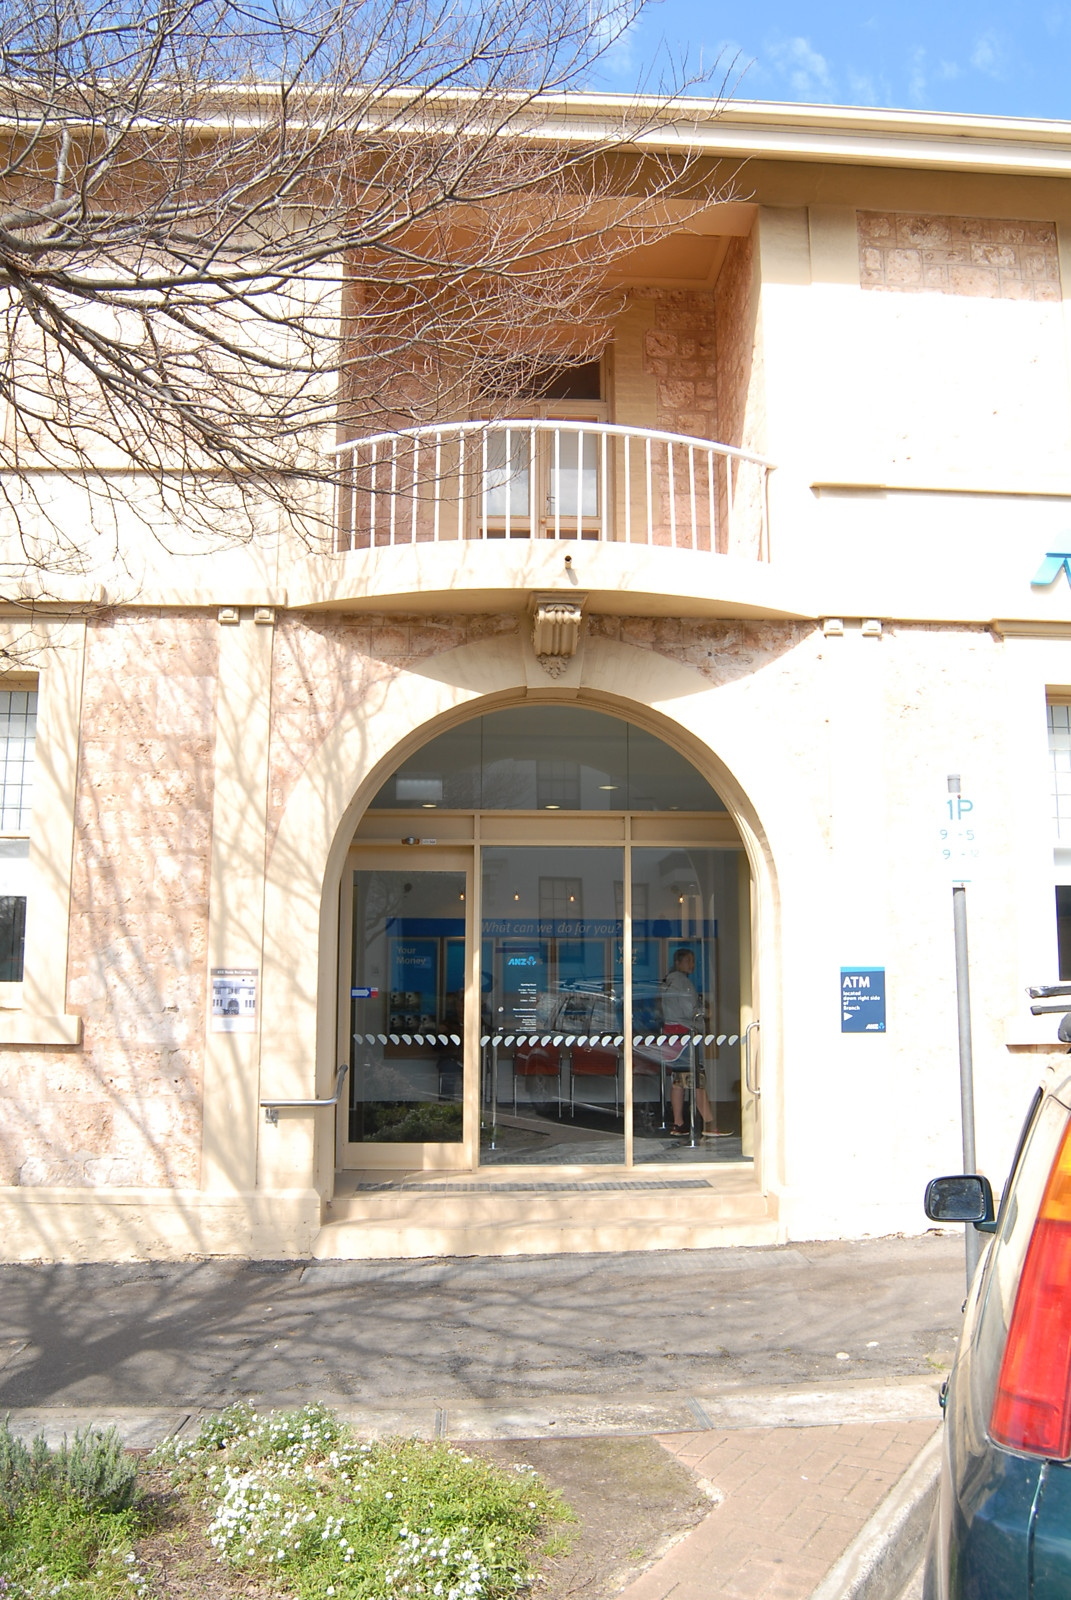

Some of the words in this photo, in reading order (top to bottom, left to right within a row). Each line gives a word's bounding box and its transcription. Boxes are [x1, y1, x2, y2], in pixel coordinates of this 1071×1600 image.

[946, 799, 974, 821] 1P
[482, 922, 510, 933] What
[513, 924, 533, 933] can
[537, 924, 552, 933] we
[557, 922, 571, 933] do
[574, 922, 591, 935] for
[593, 922, 622, 935] you?
[507, 957, 527, 966] ANZ
[842, 976, 871, 989] ATM
